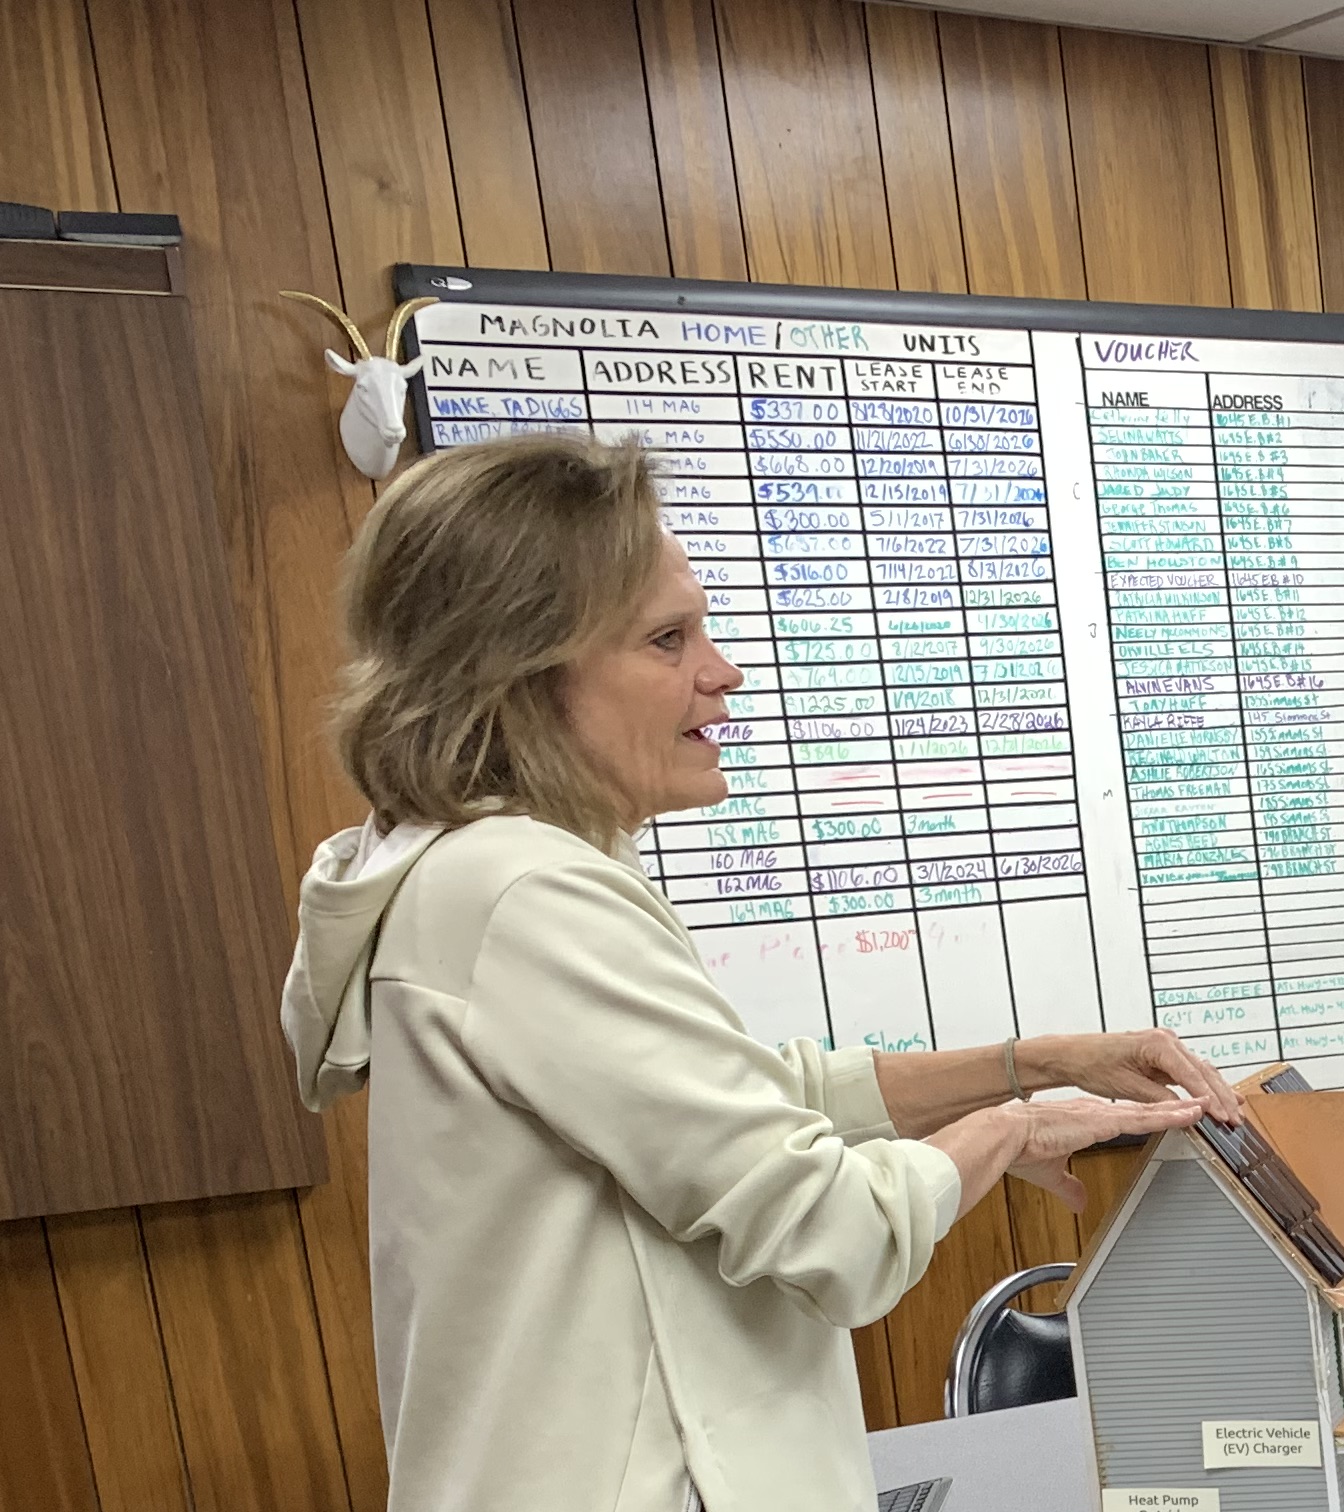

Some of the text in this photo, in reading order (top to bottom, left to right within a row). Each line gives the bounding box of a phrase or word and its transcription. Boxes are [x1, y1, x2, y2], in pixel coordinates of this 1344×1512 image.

[480, 313, 659, 338] MAGNOLIA
[903, 333, 980, 356] UNITS
[1094, 340, 1199, 363] VOUCHER
[431, 356, 546, 381] NAME
[593, 360, 731, 384] ADDRESS
[749, 362, 837, 392] RENT
[855, 362, 922, 379] LEASE
[943, 366, 1008, 380] LEASE
[862, 380, 917, 393] START
[958, 382, 1001, 395] END
[662, 400, 700, 414] MAG
[1102, 392, 1149, 407] NAME
[1213, 395, 1283, 410] ADDRESS
[665, 430, 705, 444] MAG
[751, 429, 836, 450] $550.00
[948, 433, 1033, 451] 6/30/2026
[754, 455, 845, 475] $668.00
[860, 458, 938, 475] 12/20/2019
[950, 459, 1038, 477] 7/31/2026
[677, 487, 711, 499] MAG
[865, 483, 946, 500] 12/15/2019
[681, 512, 719, 526] MAG
[765, 513, 850, 530] $300.00
[870, 510, 944, 527] 5/1/2017
[958, 510, 1034, 528] 7/31/2026
[687, 539, 726, 552] MAG
[875, 537, 946, 553] 7/6/2022
[960, 536, 1048, 555] 7/31/2026
[877, 565, 956, 581] 7/14/2022
[1110, 573, 1219, 588] EXPECTED VOUCHER
[883, 588, 952, 605] 2/8/2019
[1126, 677, 1215, 694] ALVIN EVANS
[894, 718, 969, 736] 1/24/2023
[980, 713, 1064, 732] 2/28/2026
[718, 726, 753, 740] MAG
[812, 818, 882, 838] $300.00
[710, 850, 777, 870] 160 MAG
[1001, 855, 1082, 876] 6/30/2026
[916, 860, 988, 882] 3/1/2024
[828, 892, 895, 913] $300.00
[1206, 985, 1263, 1001] COFFEE
[1203, 1006, 1246, 1024] AUTO
[1215, 1427, 1311, 1440] Electric Vehicle
[1223, 1443, 1303, 1457] (EV) Charger
[1129, 1494, 1199, 1508] Heat Pump
